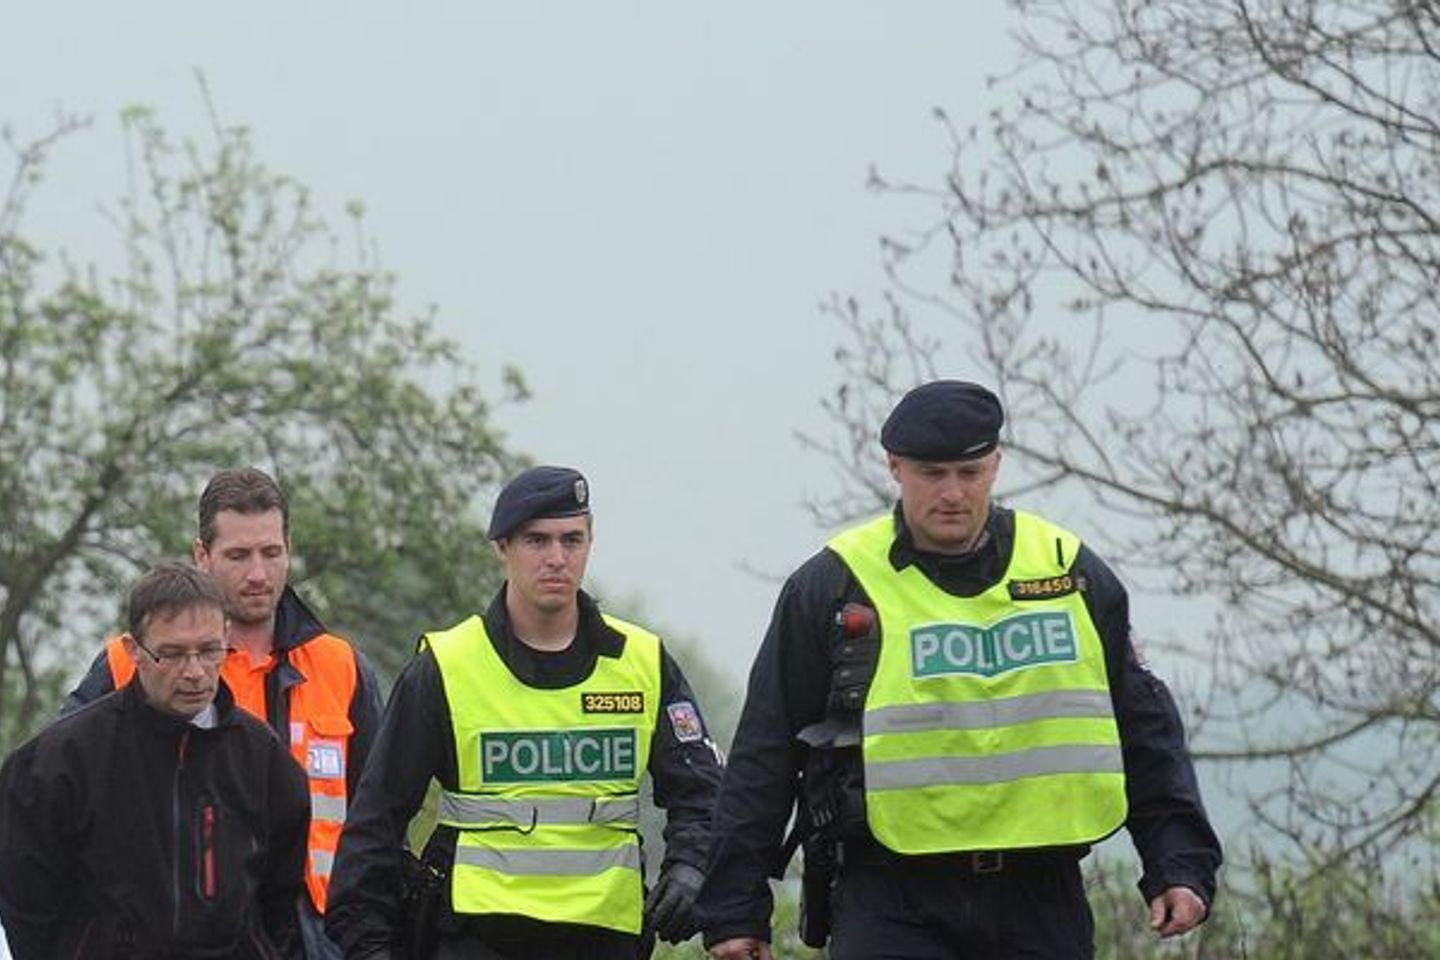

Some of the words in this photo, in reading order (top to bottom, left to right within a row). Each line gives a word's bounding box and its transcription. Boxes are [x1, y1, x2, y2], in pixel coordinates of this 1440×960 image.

[913, 619, 1072, 670] POLICIE
[585, 695, 642, 711] 325108
[484, 736, 633, 775] POLICIE
